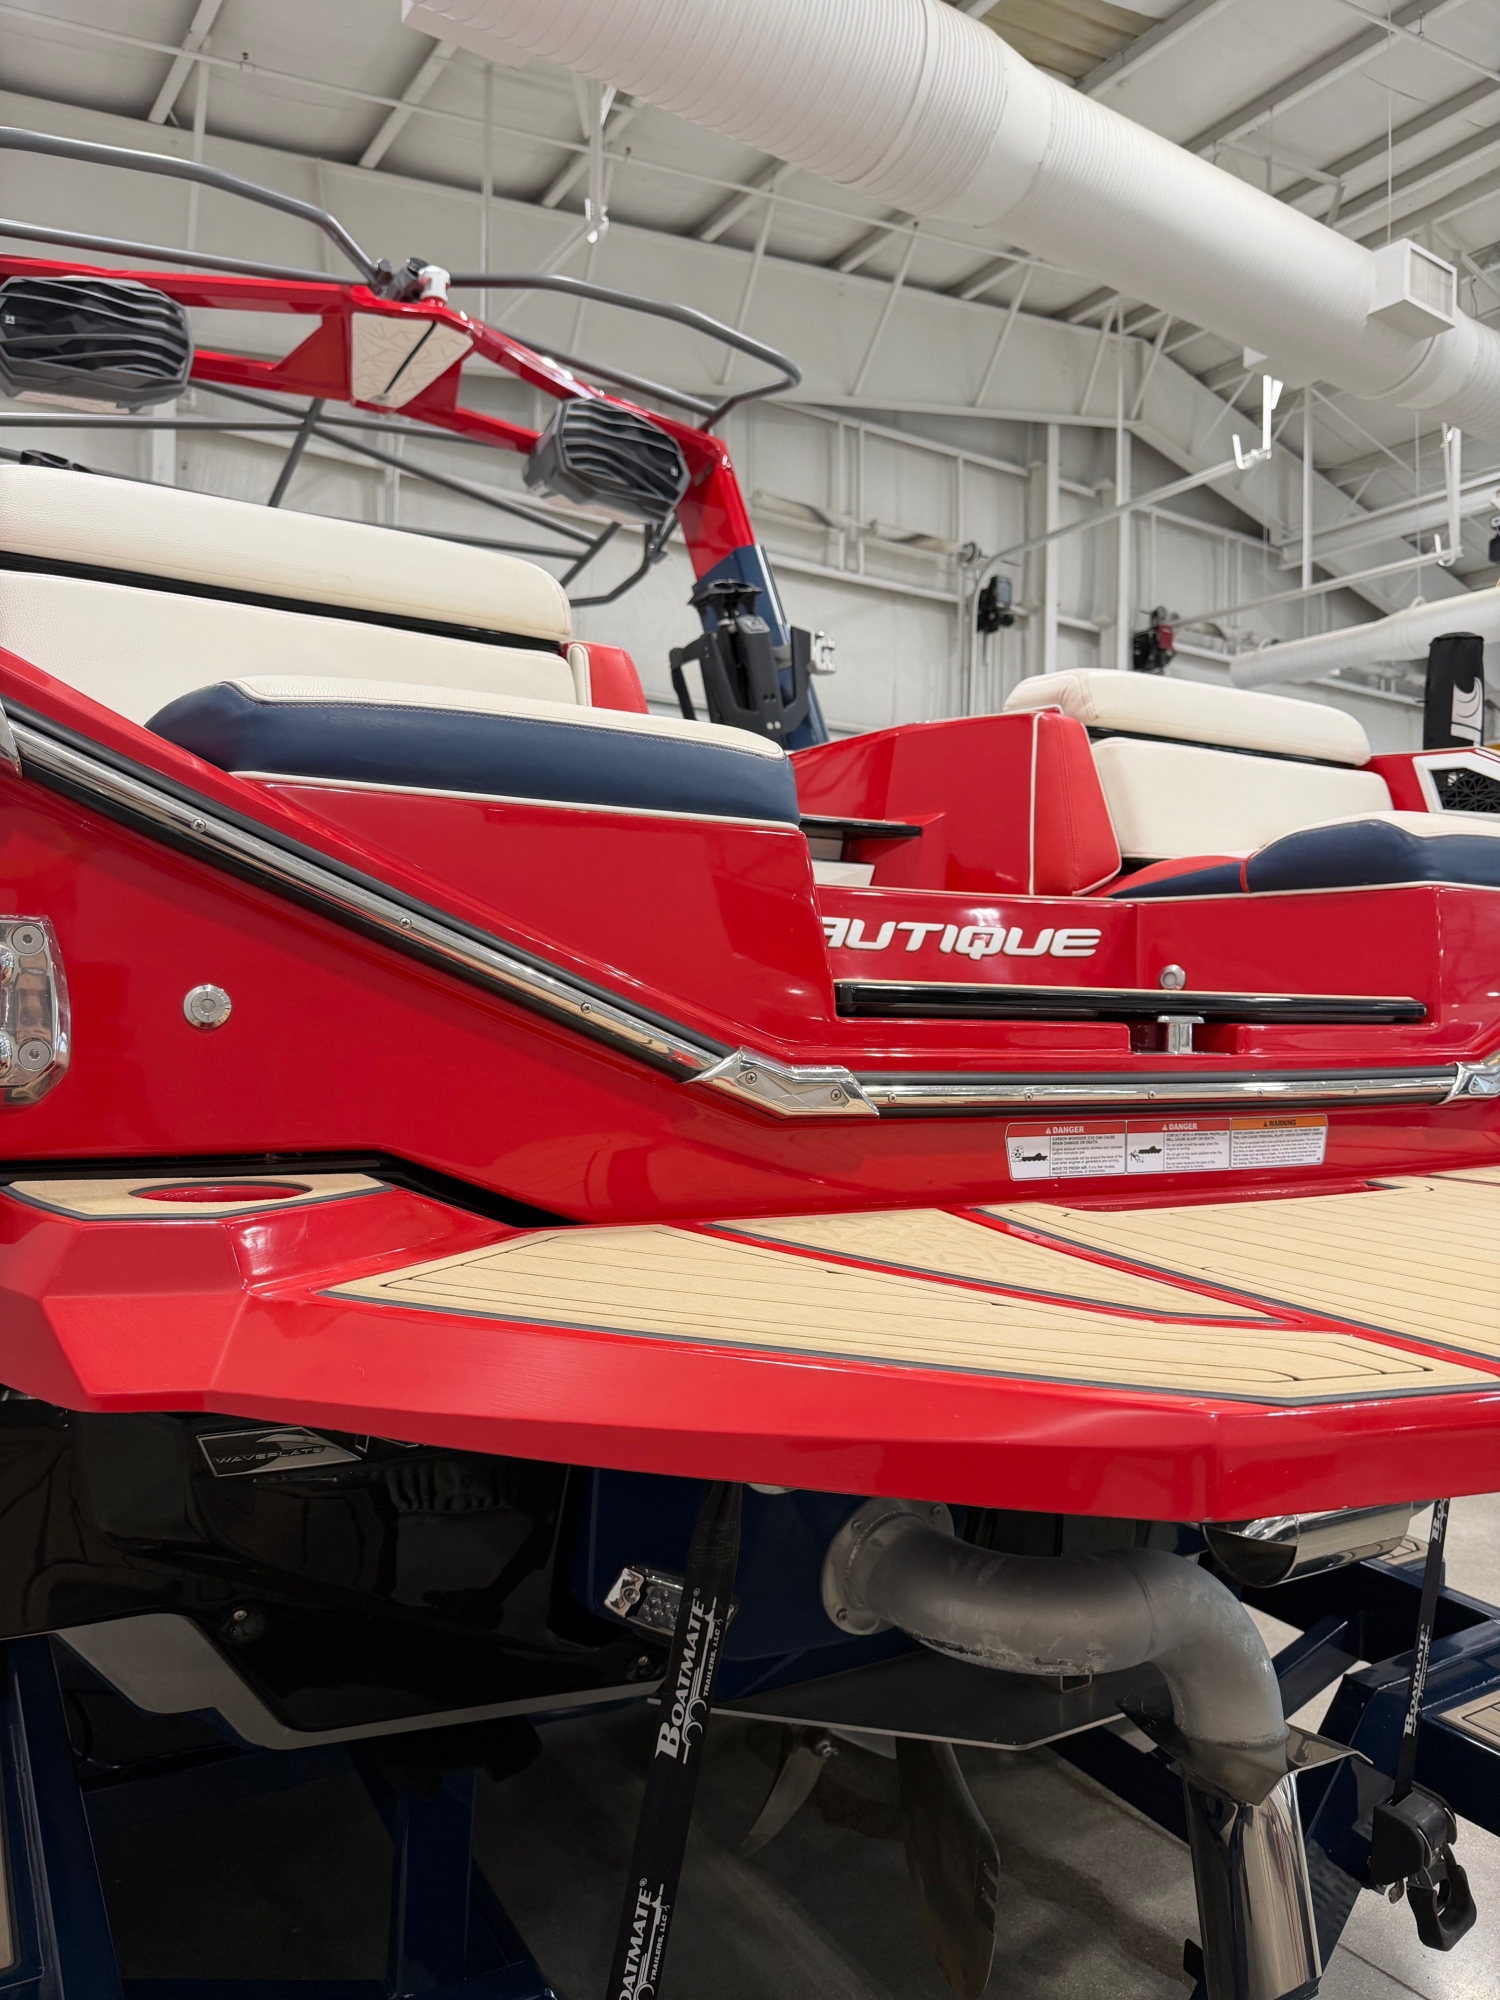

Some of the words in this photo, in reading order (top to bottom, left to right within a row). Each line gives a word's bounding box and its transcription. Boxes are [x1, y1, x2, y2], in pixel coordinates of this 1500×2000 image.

[821, 916, 1102, 960] AUTIQUE
[1052, 1126, 1084, 1134] DANGER
[214, 1447, 322, 1464] WAVEPLATE
[703, 1649, 718, 1697] TRAILERS,
[712, 1628, 721, 1647] LLC
[651, 1934, 665, 1981] TRAILERS,
[660, 1914, 668, 1932] LLC
